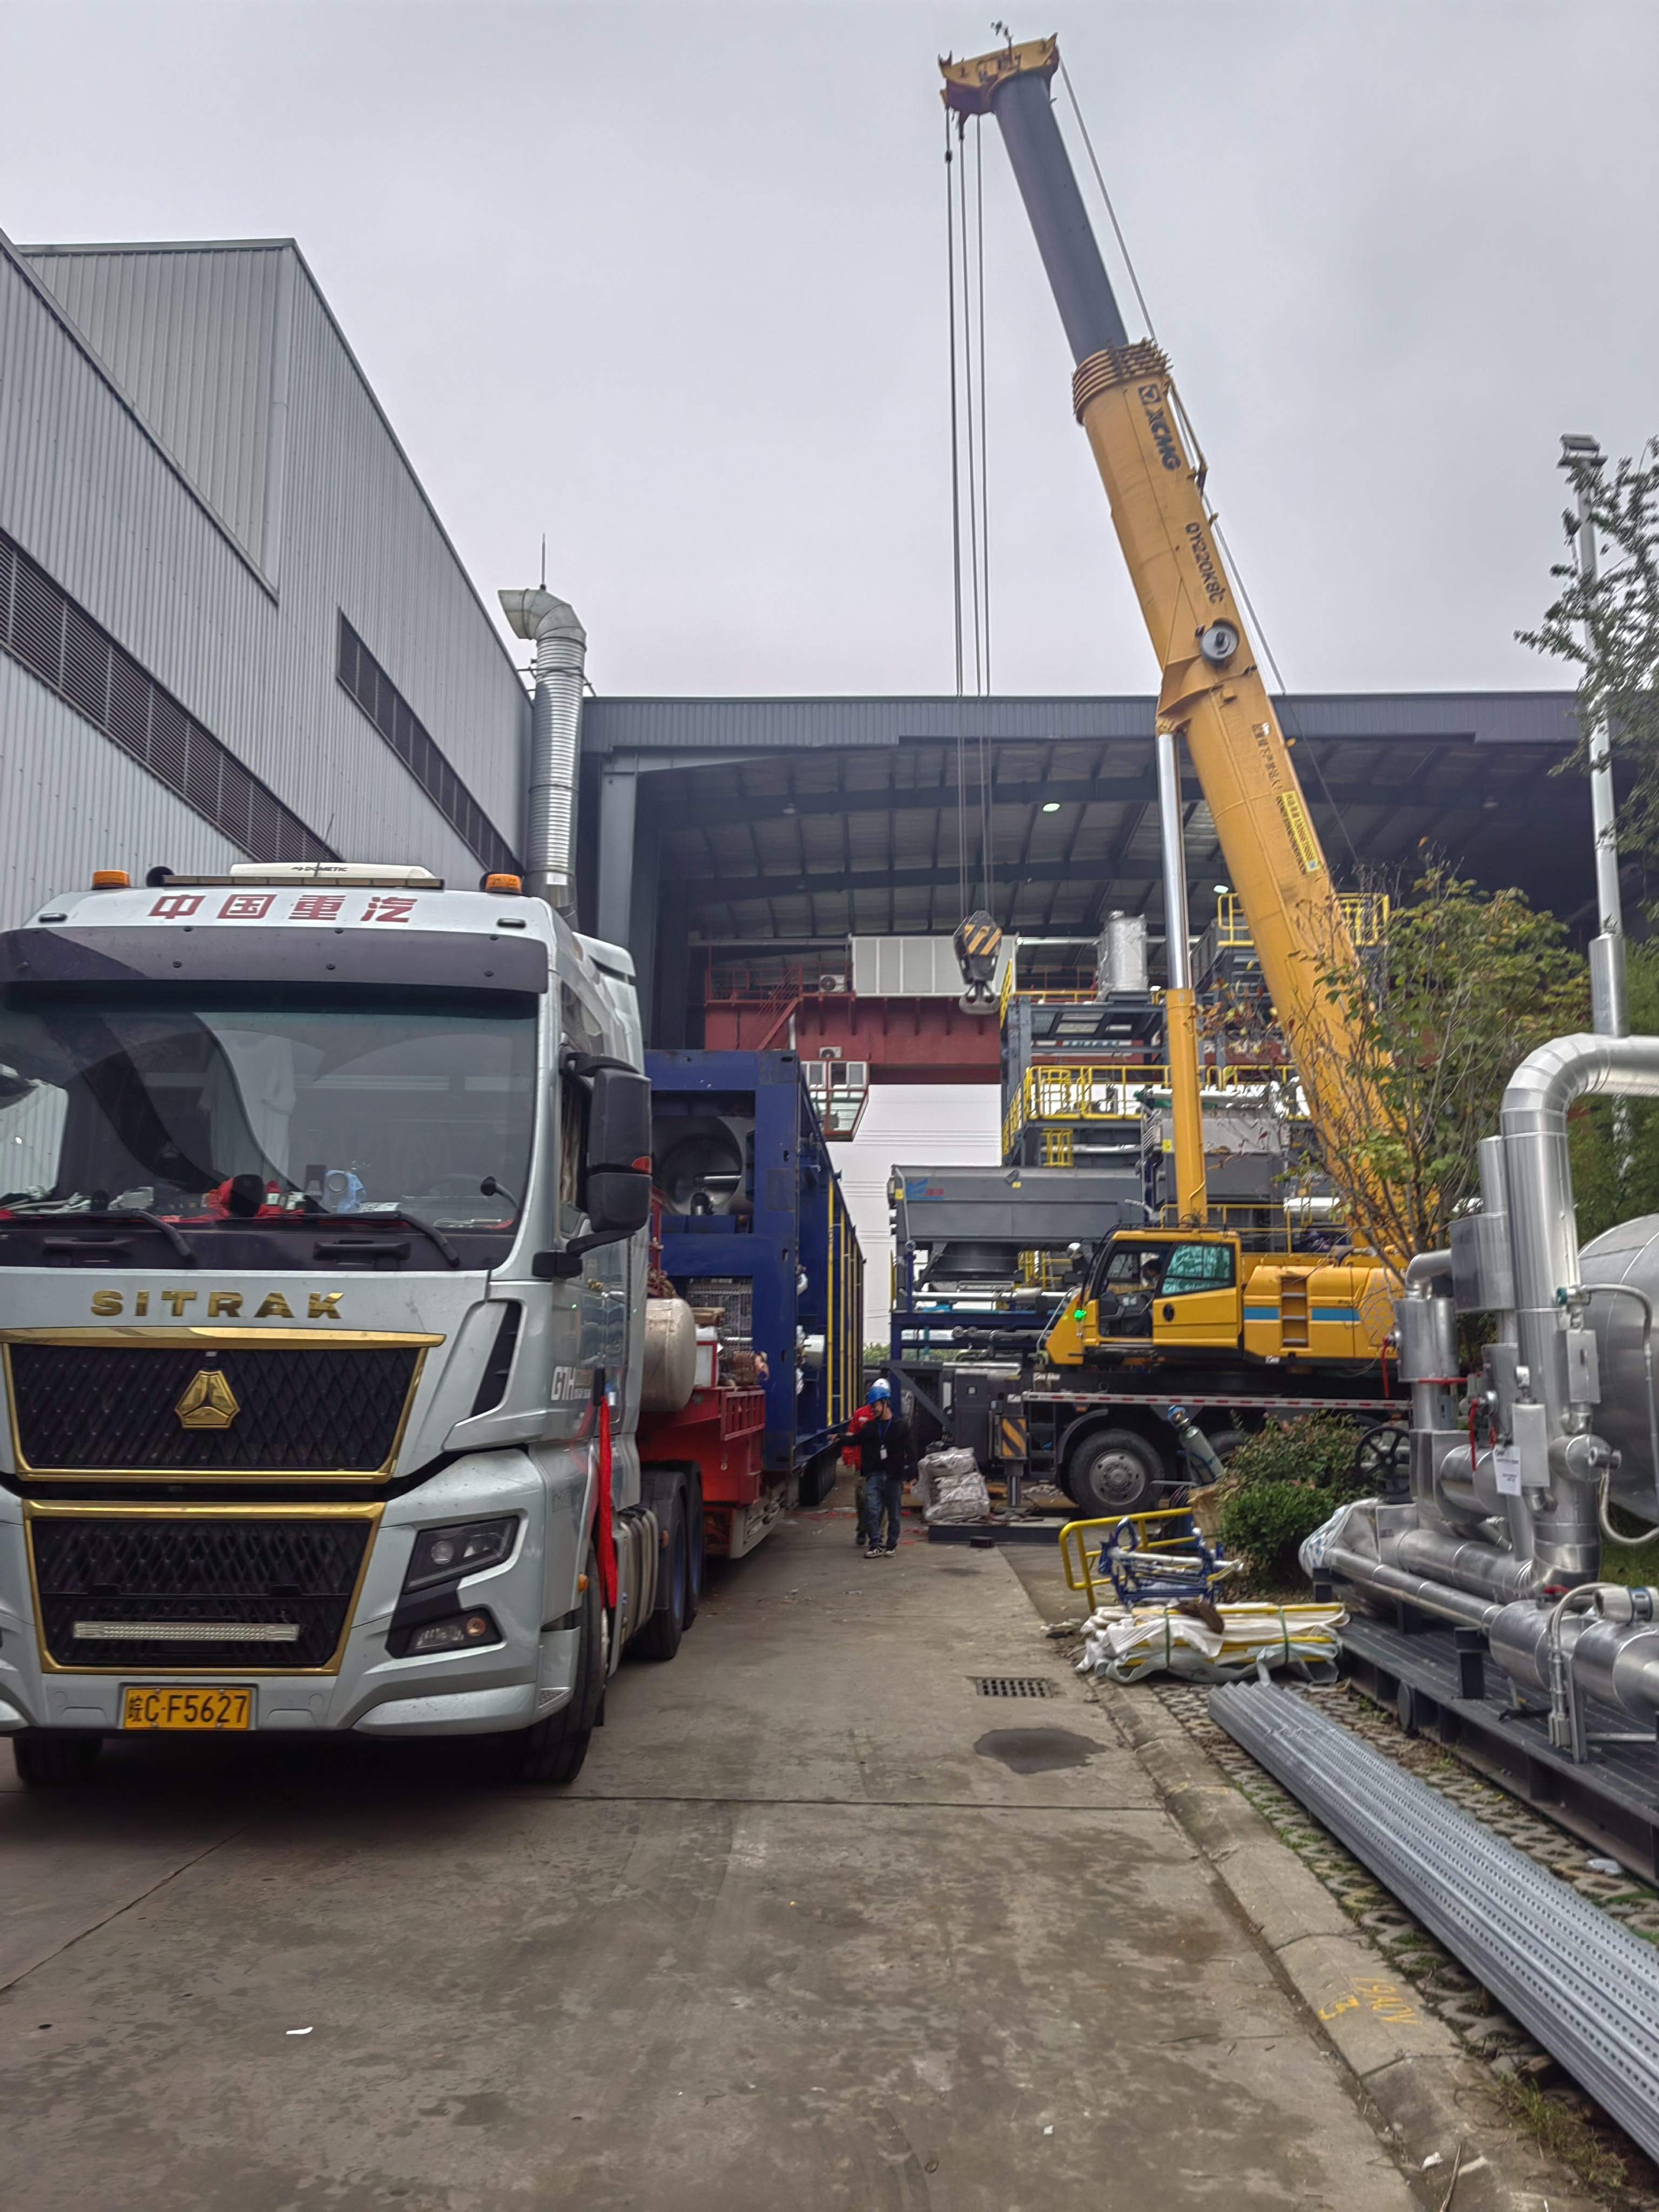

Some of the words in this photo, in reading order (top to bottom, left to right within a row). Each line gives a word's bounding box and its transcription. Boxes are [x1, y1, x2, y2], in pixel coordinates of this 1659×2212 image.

[1145, 407, 1181, 471] XCMG
[147, 894, 417, 923] 中国重汽
[91, 1290, 345, 1319] SITRAK
